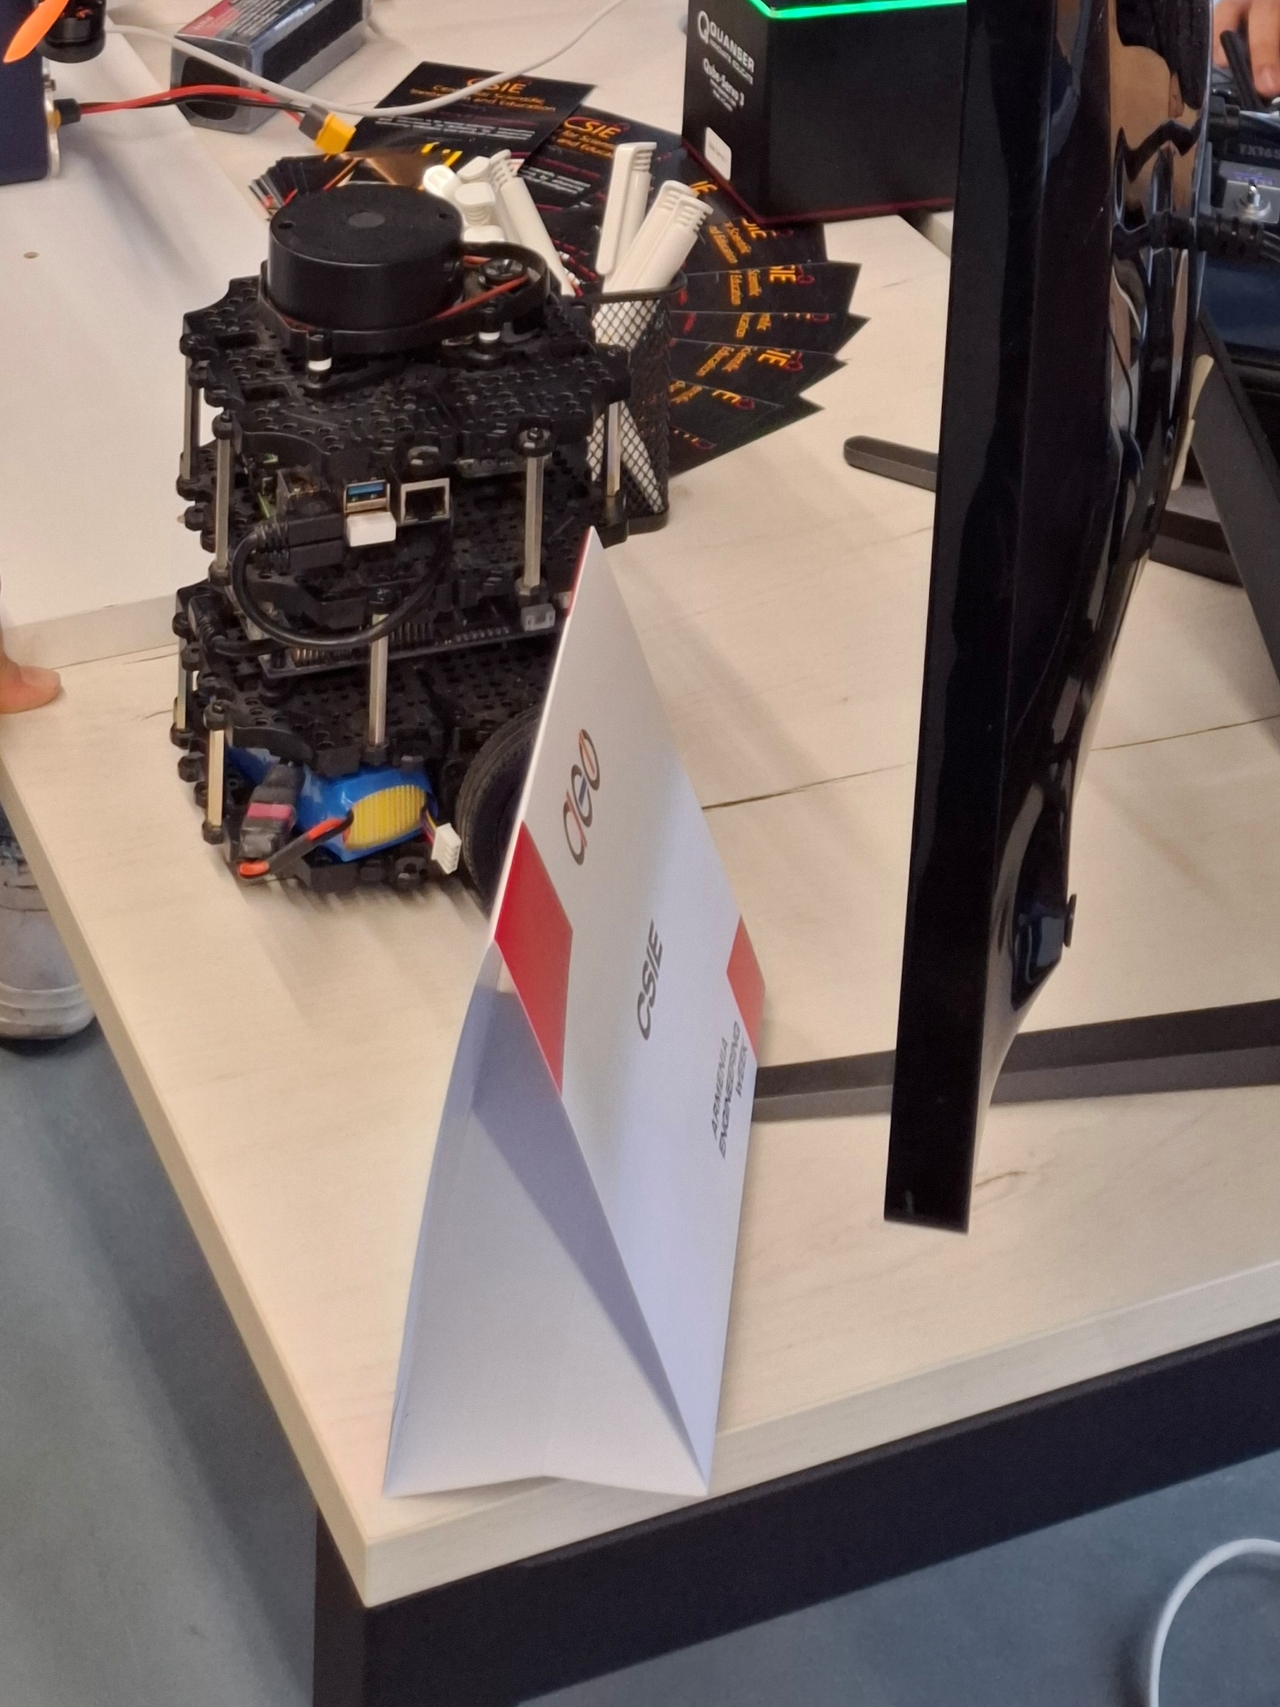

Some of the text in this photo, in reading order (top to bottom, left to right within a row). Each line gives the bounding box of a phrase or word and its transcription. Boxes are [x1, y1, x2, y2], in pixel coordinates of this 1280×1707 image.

[710, 21, 755, 73] QUANSER
[563, 117, 621, 139] CSIE
[637, 919, 663, 1041] CSIE
[712, 1036, 728, 1140] ARMENIA
[719, 1020, 741, 1159] ENGINEERING
